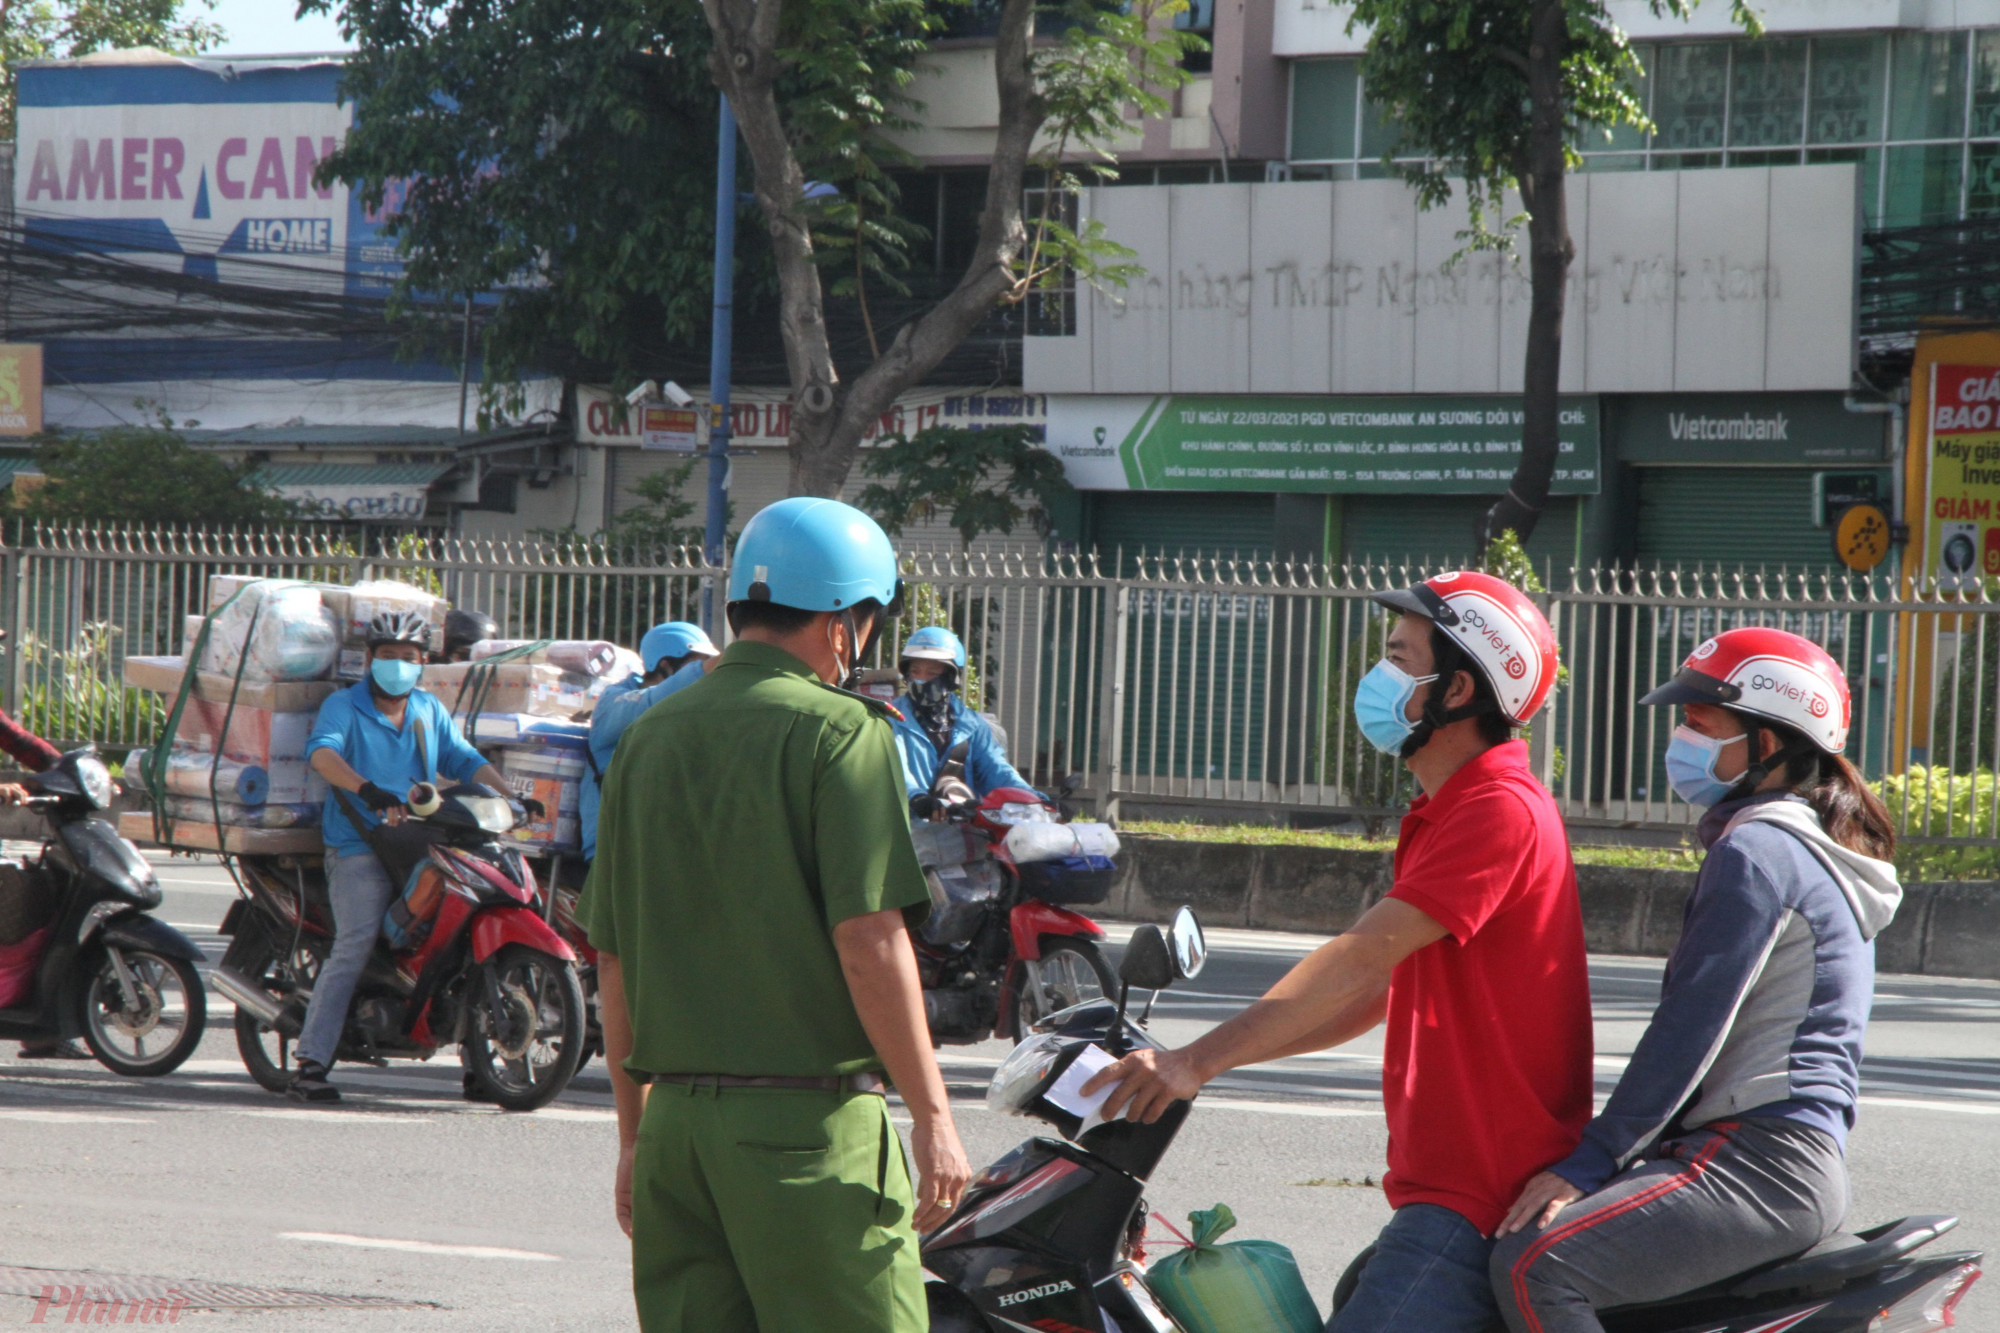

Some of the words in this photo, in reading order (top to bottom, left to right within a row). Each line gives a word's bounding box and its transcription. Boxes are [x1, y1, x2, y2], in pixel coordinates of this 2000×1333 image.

[247, 220, 328, 252] HOME
[1199, 408, 1229, 424] NGÀY
[1232, 412, 1299, 425] 22/03/2021
[1301, 412, 1326, 426] PGD
[1329, 412, 1415, 426] VIETCOMBANK
[1418, 412, 1436, 425] AN
[1438, 411, 1482, 425] SƯƠNG
[1512, 411, 1525, 425] V
[1668, 412, 1788, 440] Vietcombank
[1935, 405, 1992, 430] BAO
[1060, 444, 1116, 458] Vietcombank
[1181, 441, 1199, 451] KHU
[1313, 442, 1332, 453] KCN
[1558, 442, 1574, 453] CM
[1936, 438, 1971, 463] Máy
[1230, 467, 1287, 479] VIETCOMBANK
[1573, 470, 1595, 481] HCM
[998, 1279, 1076, 1307] HONDA
